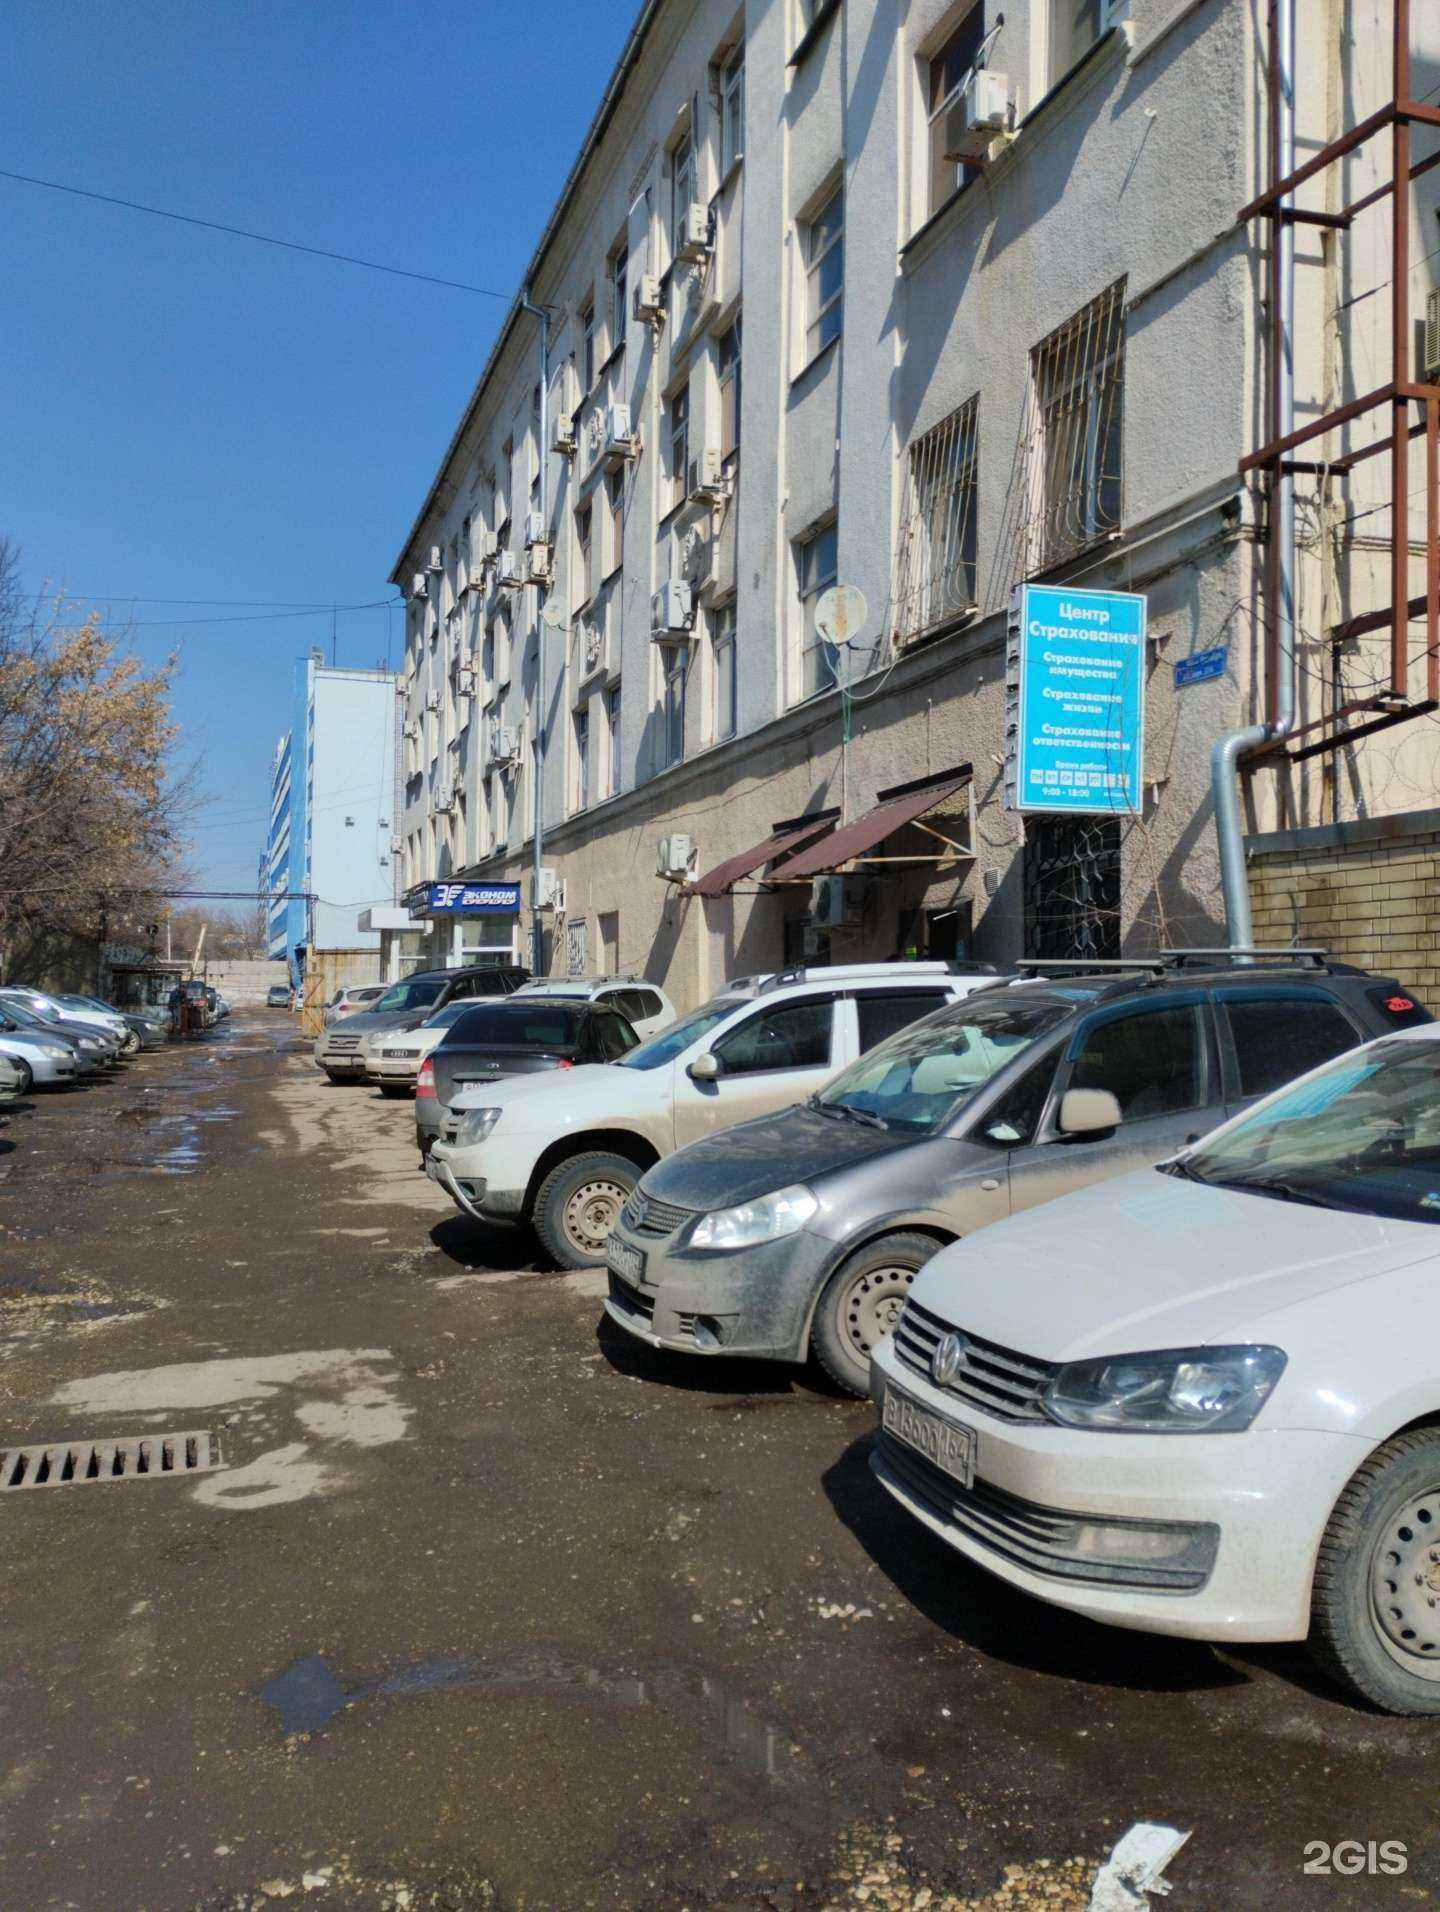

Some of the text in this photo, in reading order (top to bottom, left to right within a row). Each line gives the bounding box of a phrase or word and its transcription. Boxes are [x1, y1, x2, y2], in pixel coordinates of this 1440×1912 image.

[1059, 602, 1110, 624] Центр
[1029, 621, 1138, 644] Страхования
[1043, 652, 1123, 668] Страхование
[1049, 666, 1117, 679] имущества
[1042, 687, 1122, 703] Страхование
[1041, 723, 1121, 738] Страхование
[463, 890, 517, 899] ЭКОНОМ
